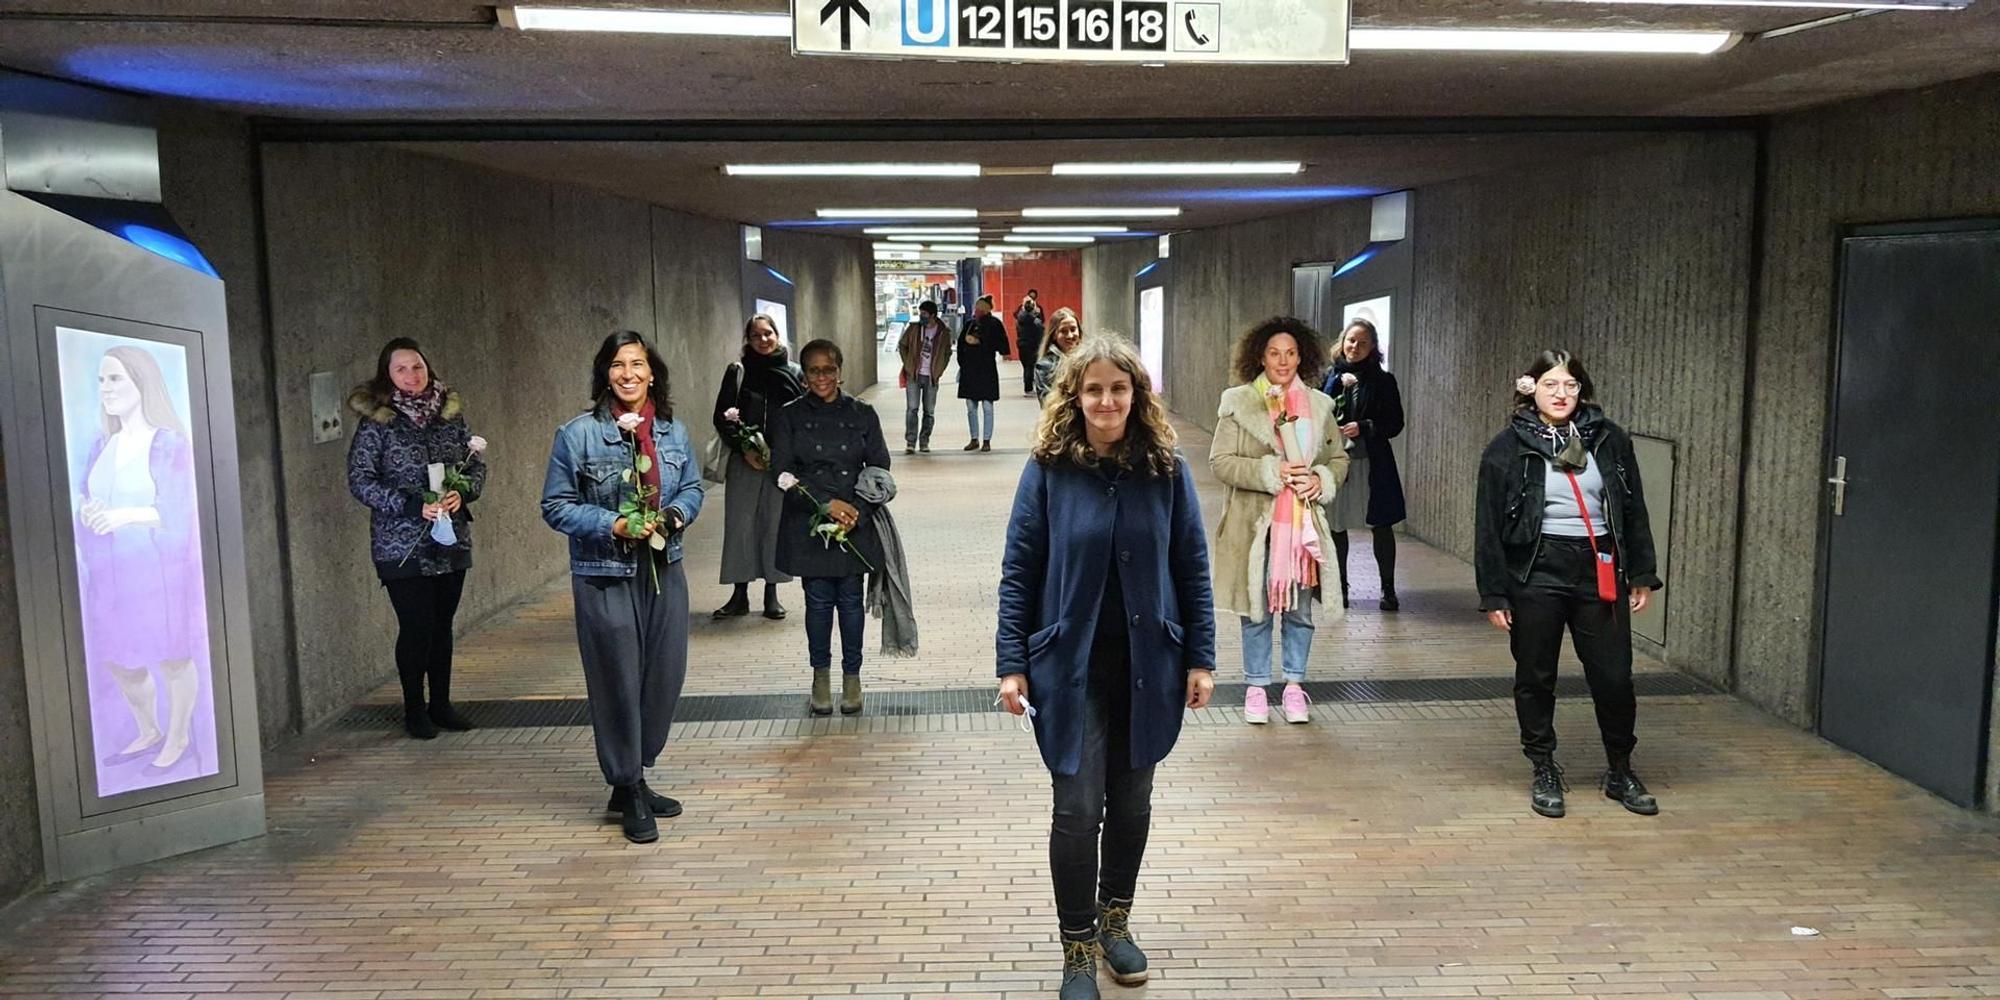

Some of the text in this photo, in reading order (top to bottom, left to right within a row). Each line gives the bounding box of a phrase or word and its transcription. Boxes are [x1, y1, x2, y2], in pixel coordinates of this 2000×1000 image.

[906, 0, 1164, 44] U 12 15 16 18
